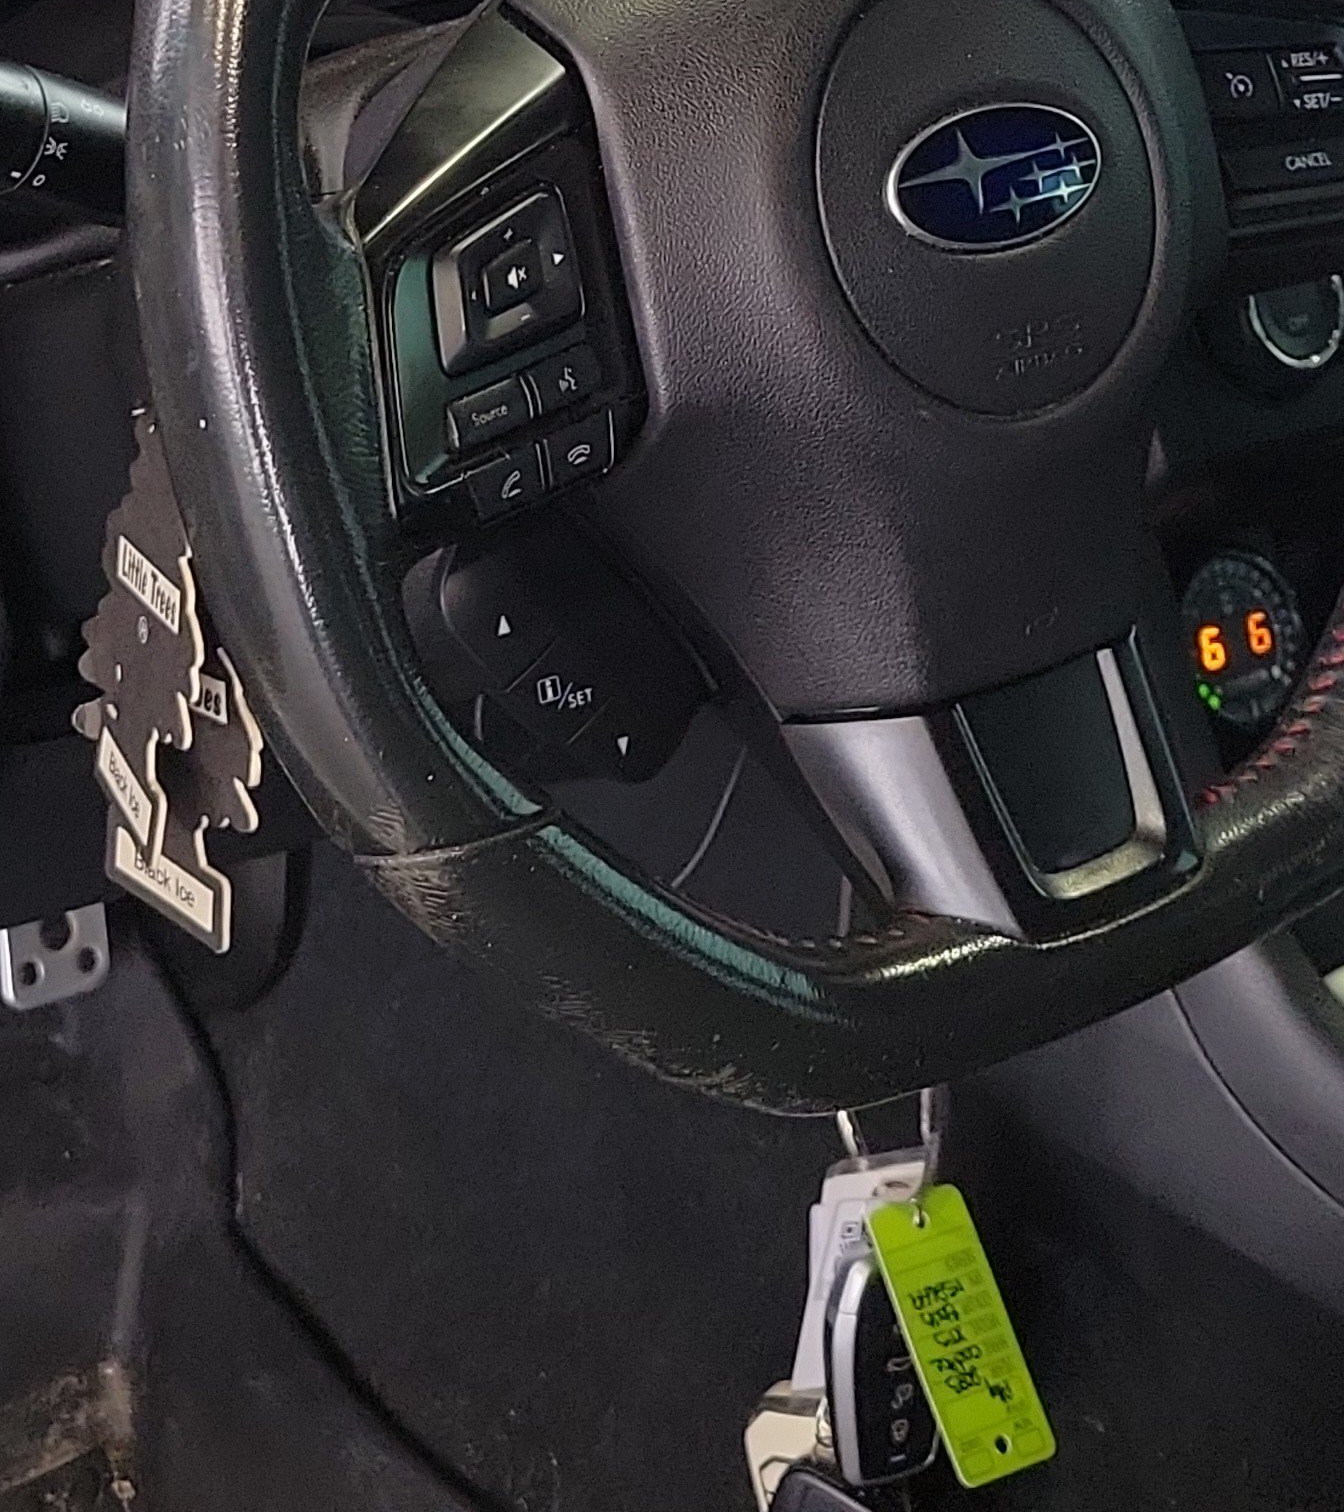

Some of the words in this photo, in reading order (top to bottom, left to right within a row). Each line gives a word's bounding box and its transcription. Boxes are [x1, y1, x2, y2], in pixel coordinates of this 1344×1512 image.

[1284, 151, 1333, 171] CANCEL
[471, 404, 509, 428] Source
[122, 542, 148, 597] Little
[150, 571, 178, 626] Trees
[175, 876, 196, 908] Ice
